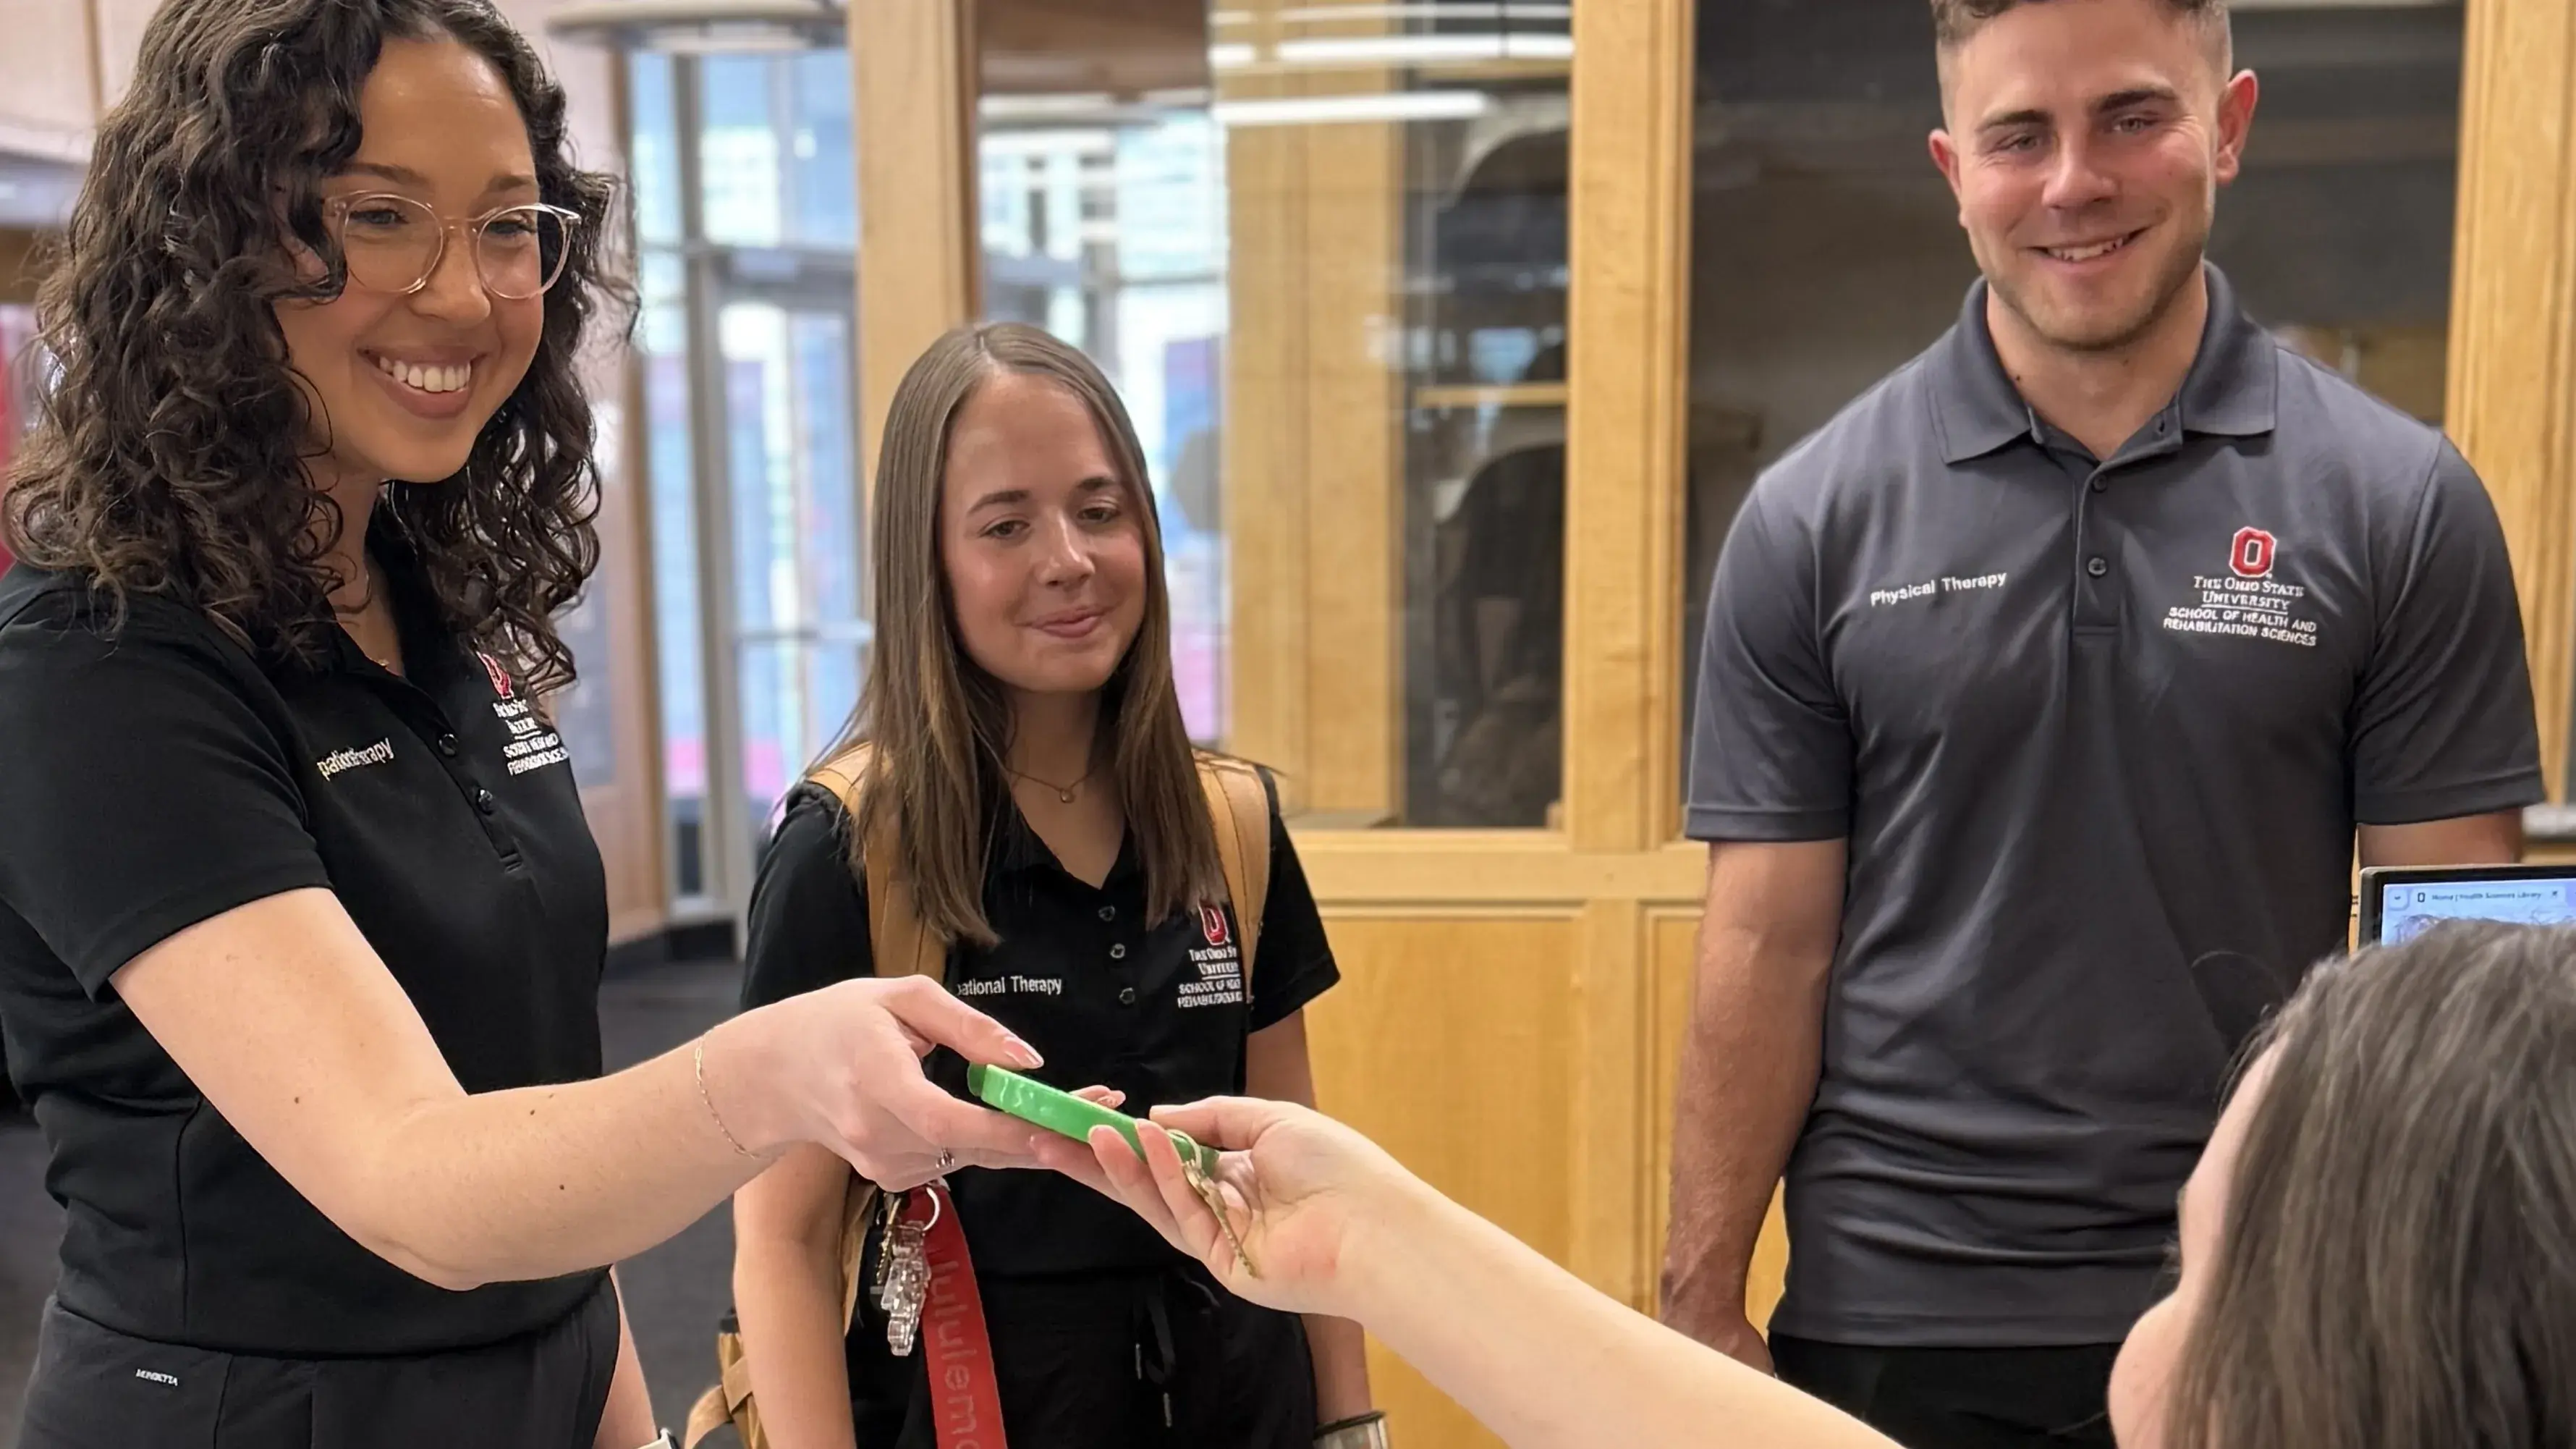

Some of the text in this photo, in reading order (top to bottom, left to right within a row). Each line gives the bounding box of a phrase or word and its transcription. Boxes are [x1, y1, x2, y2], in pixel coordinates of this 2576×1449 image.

[2229, 526, 2277, 578] O
[1870, 573, 2007, 607] Physical Therapy
[2163, 617, 2317, 646] REHABILITATION SCIENCES
[2169, 607, 2317, 633] SCHOOL OF HEALTH AND
[1010, 976, 1062, 995] Therapy
